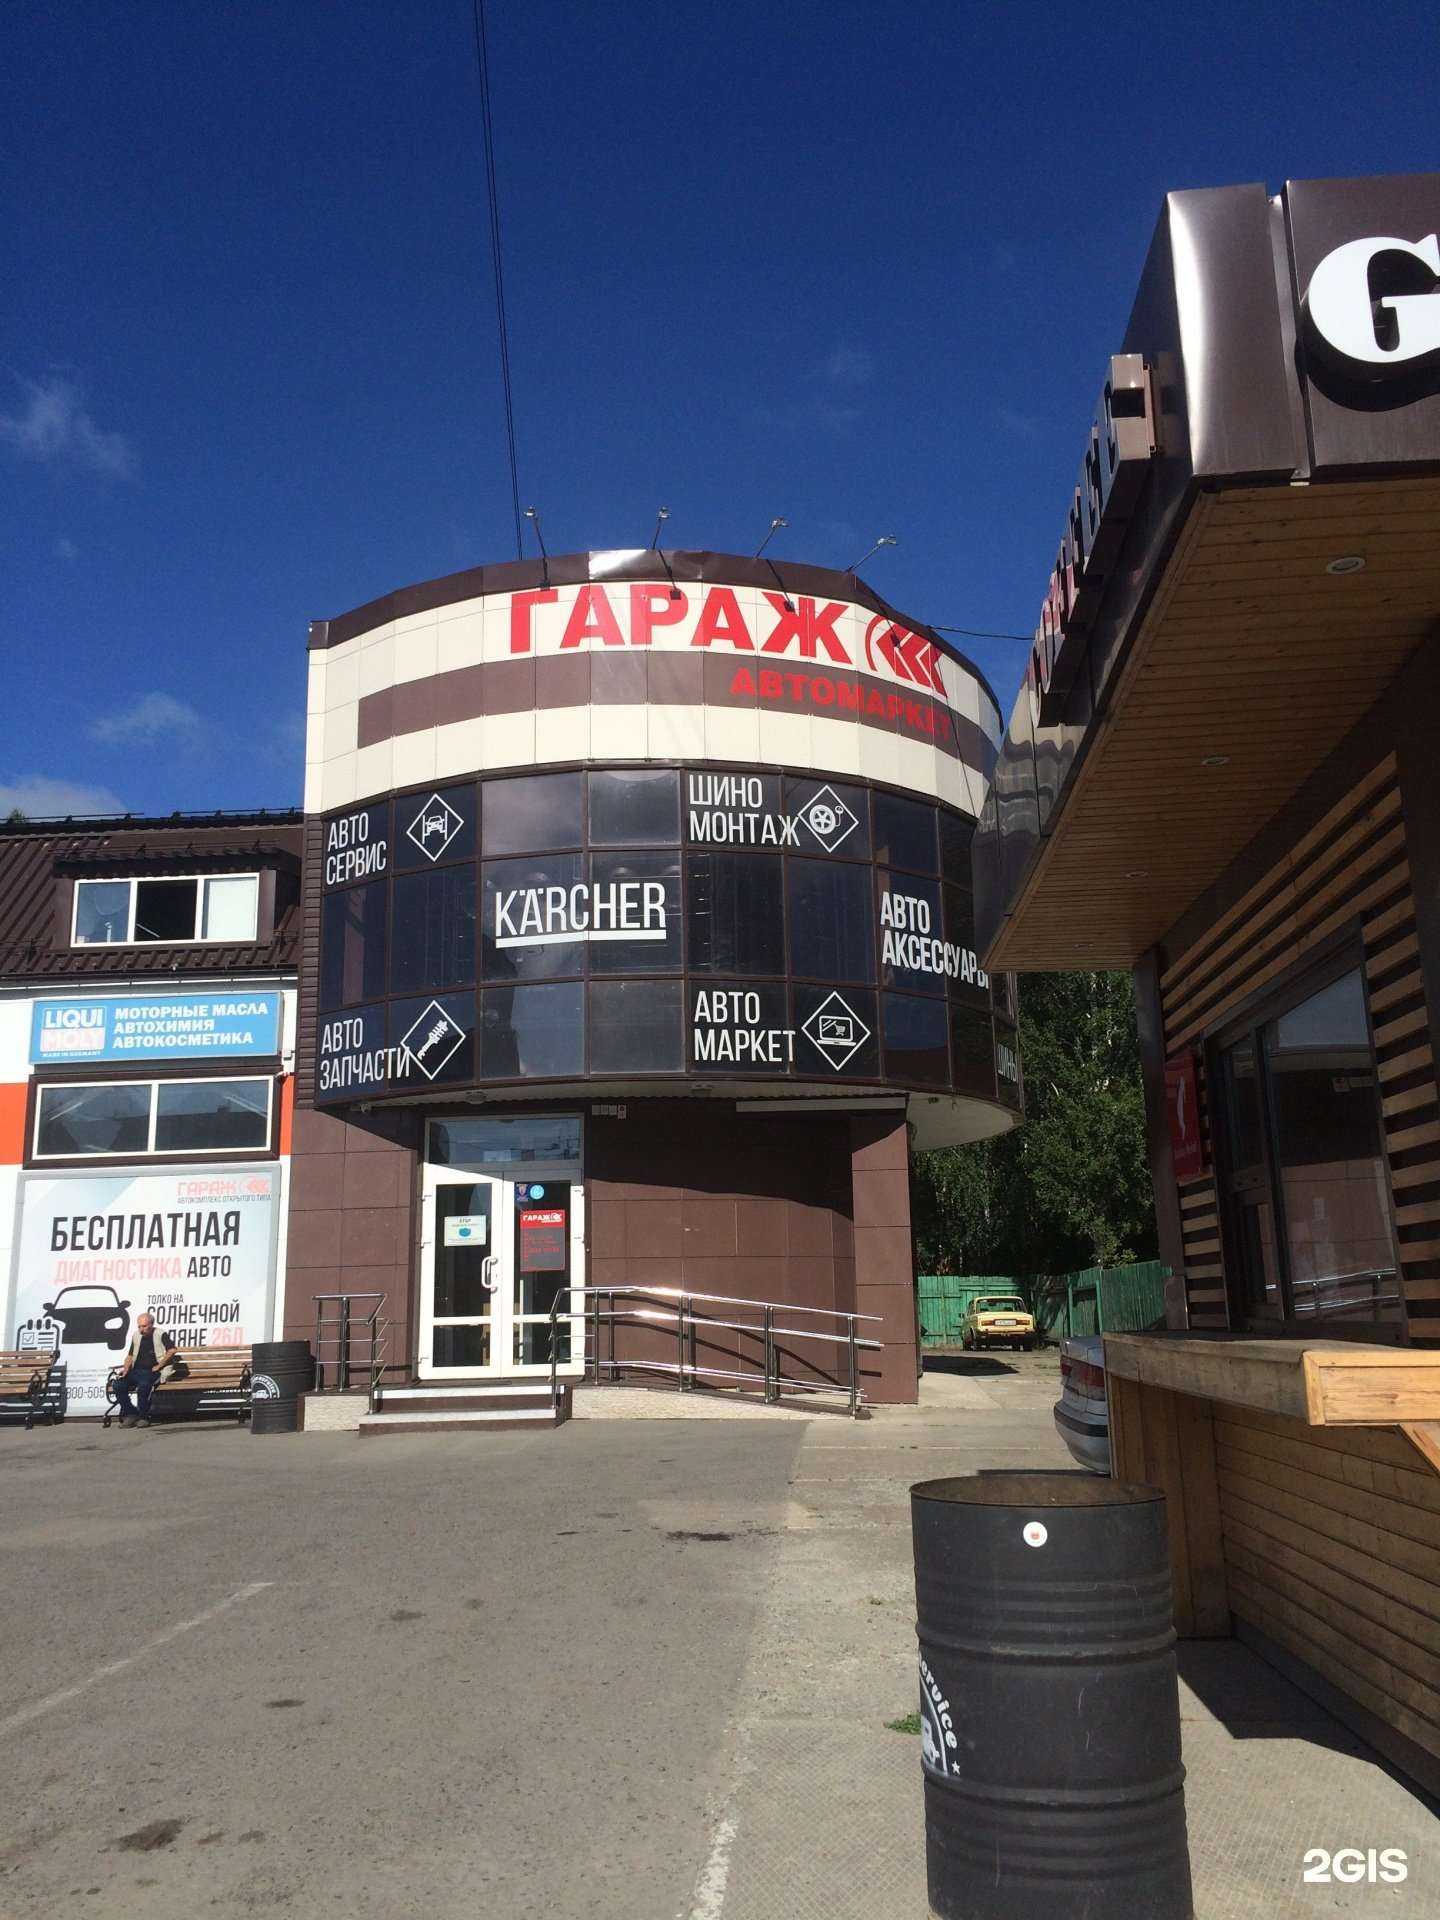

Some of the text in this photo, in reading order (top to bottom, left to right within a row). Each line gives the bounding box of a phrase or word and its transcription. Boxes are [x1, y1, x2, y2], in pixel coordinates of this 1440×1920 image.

[510, 584, 853, 665] ГАРАЖ
[729, 667, 953, 742] АВТОМАРКЕТ
[689, 774, 763, 808] ШИНО
[327, 811, 369, 852] АВТО
[689, 810, 801, 847] МОНТАЖ
[325, 840, 388, 885] СЕРВИС
[495, 882, 667, 937] KÄRCHER
[880, 890, 931, 934] АВТО
[45, 1008, 104, 1028] LIQUI
[114, 1002, 268, 1020] МОТОРНЫЕ МАСЛА
[694, 990, 761, 1025] АВТО
[112, 1031, 253, 1049] АВТОКОСМЕТИКА
[113, 1019, 215, 1034] АВТОХИМИЯ
[321, 1016, 363, 1054] АВТО
[694, 1028, 796, 1062] МАРКЕТ
[319, 1046, 411, 1090] ЗАПЧАСТИ
[50, 1210, 241, 1252] БЕСПЛАТНАЯ
[54, 1255, 232, 1285] ДИАГНОСТИКА АВТО
[147, 1294, 184, 1305] ТОЛКО НА
